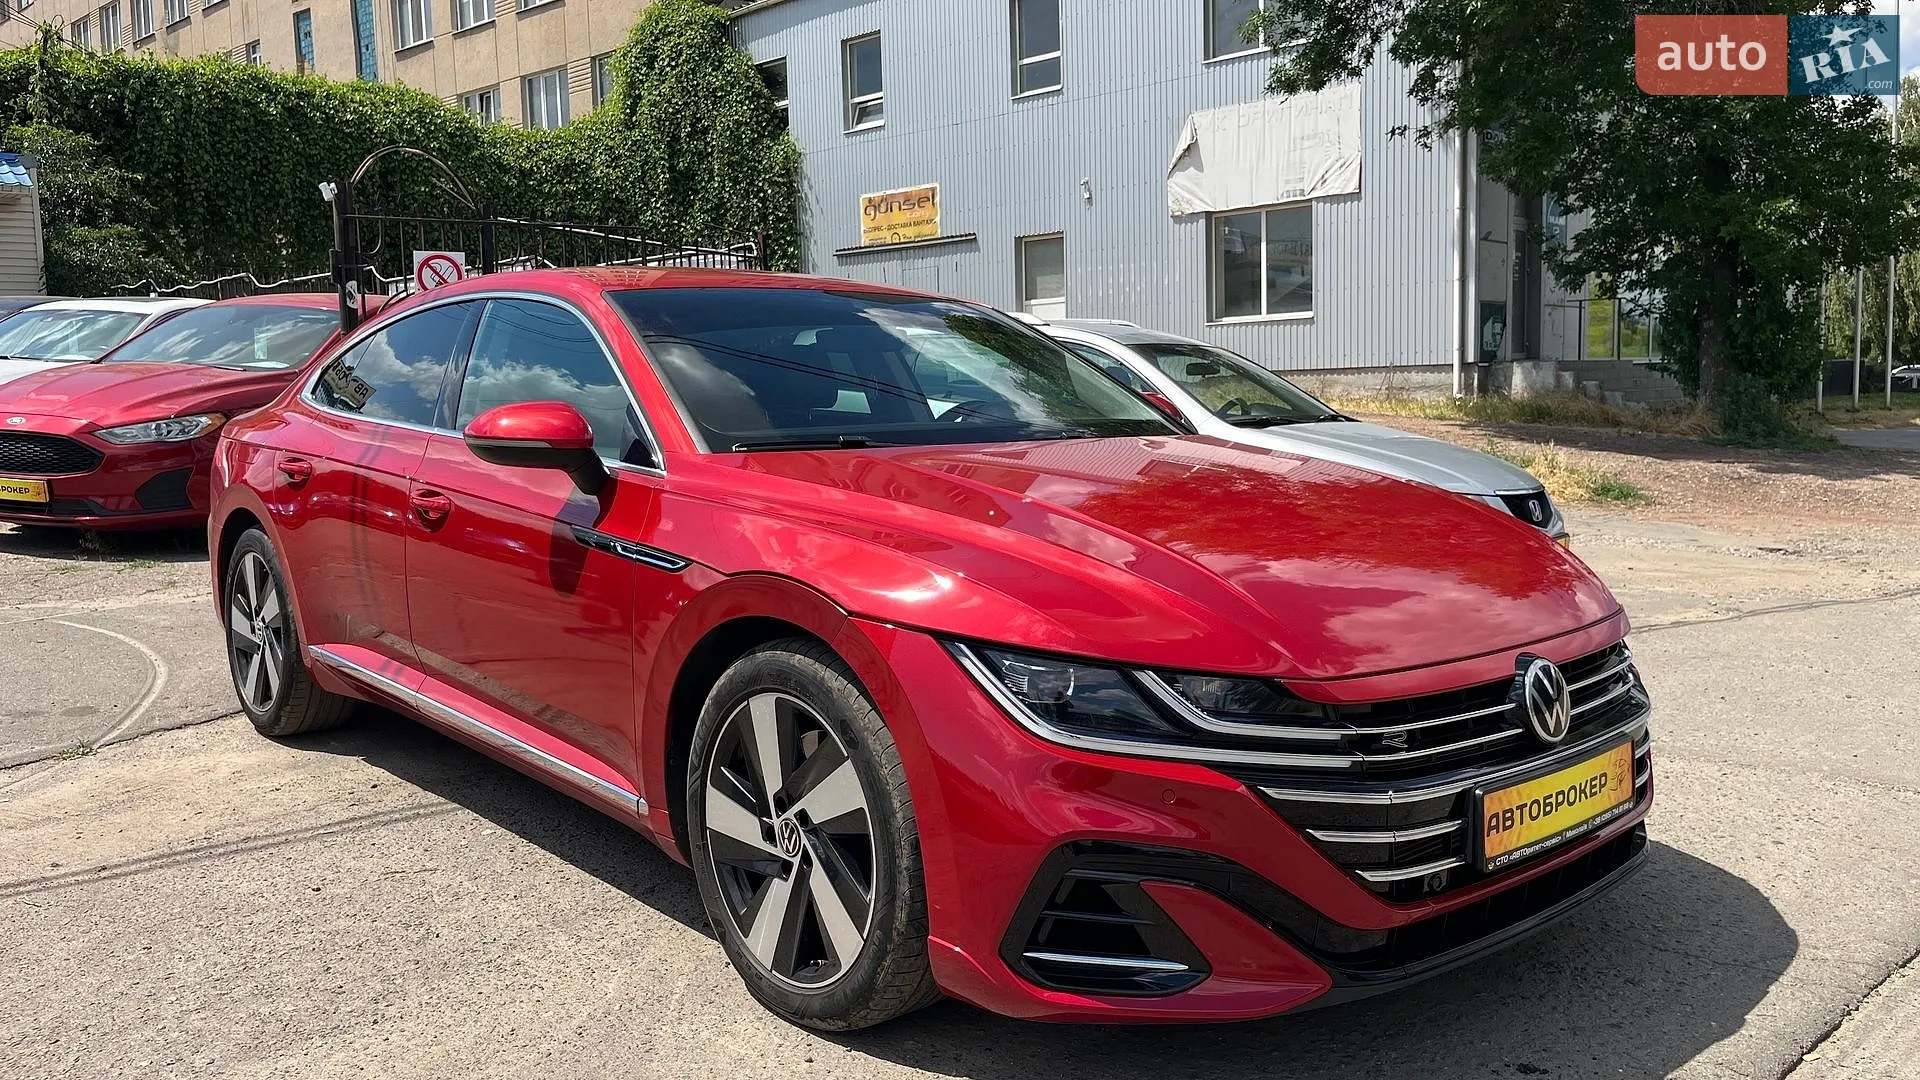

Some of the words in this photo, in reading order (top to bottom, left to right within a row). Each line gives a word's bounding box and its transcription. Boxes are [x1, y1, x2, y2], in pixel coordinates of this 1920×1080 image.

[864, 188, 936, 221] günsel
[1486, 771, 1608, 838] АВТОБРОКЕР
[1495, 854, 1509, 866] СТО
